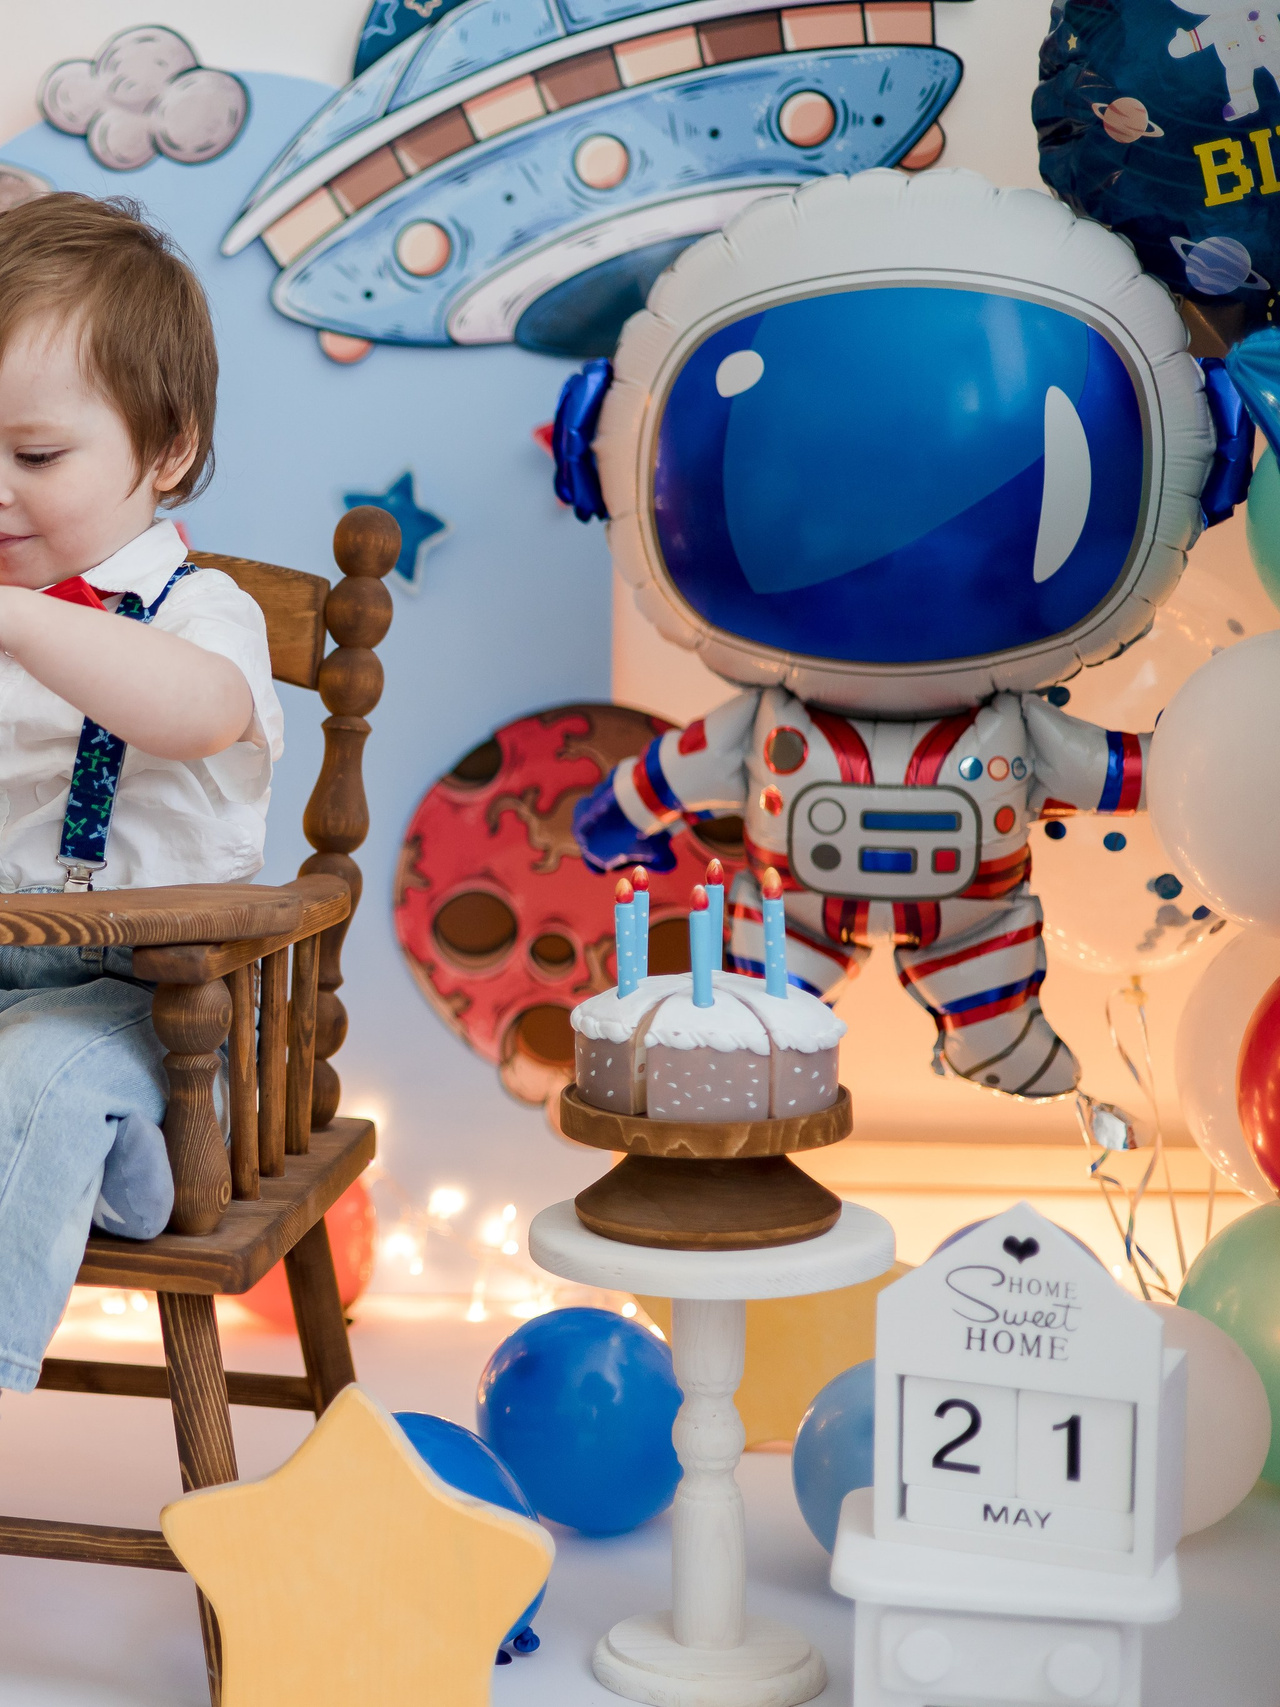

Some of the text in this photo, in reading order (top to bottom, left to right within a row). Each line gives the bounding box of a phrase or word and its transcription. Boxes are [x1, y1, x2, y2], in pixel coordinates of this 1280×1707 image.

[1193, 125, 1280, 207] BI
[945, 1265, 1082, 1332] Sweet
[1008, 1276, 1078, 1300] HOME
[965, 1326, 1069, 1361] HOME
[983, 1503, 1052, 1529] MAY
